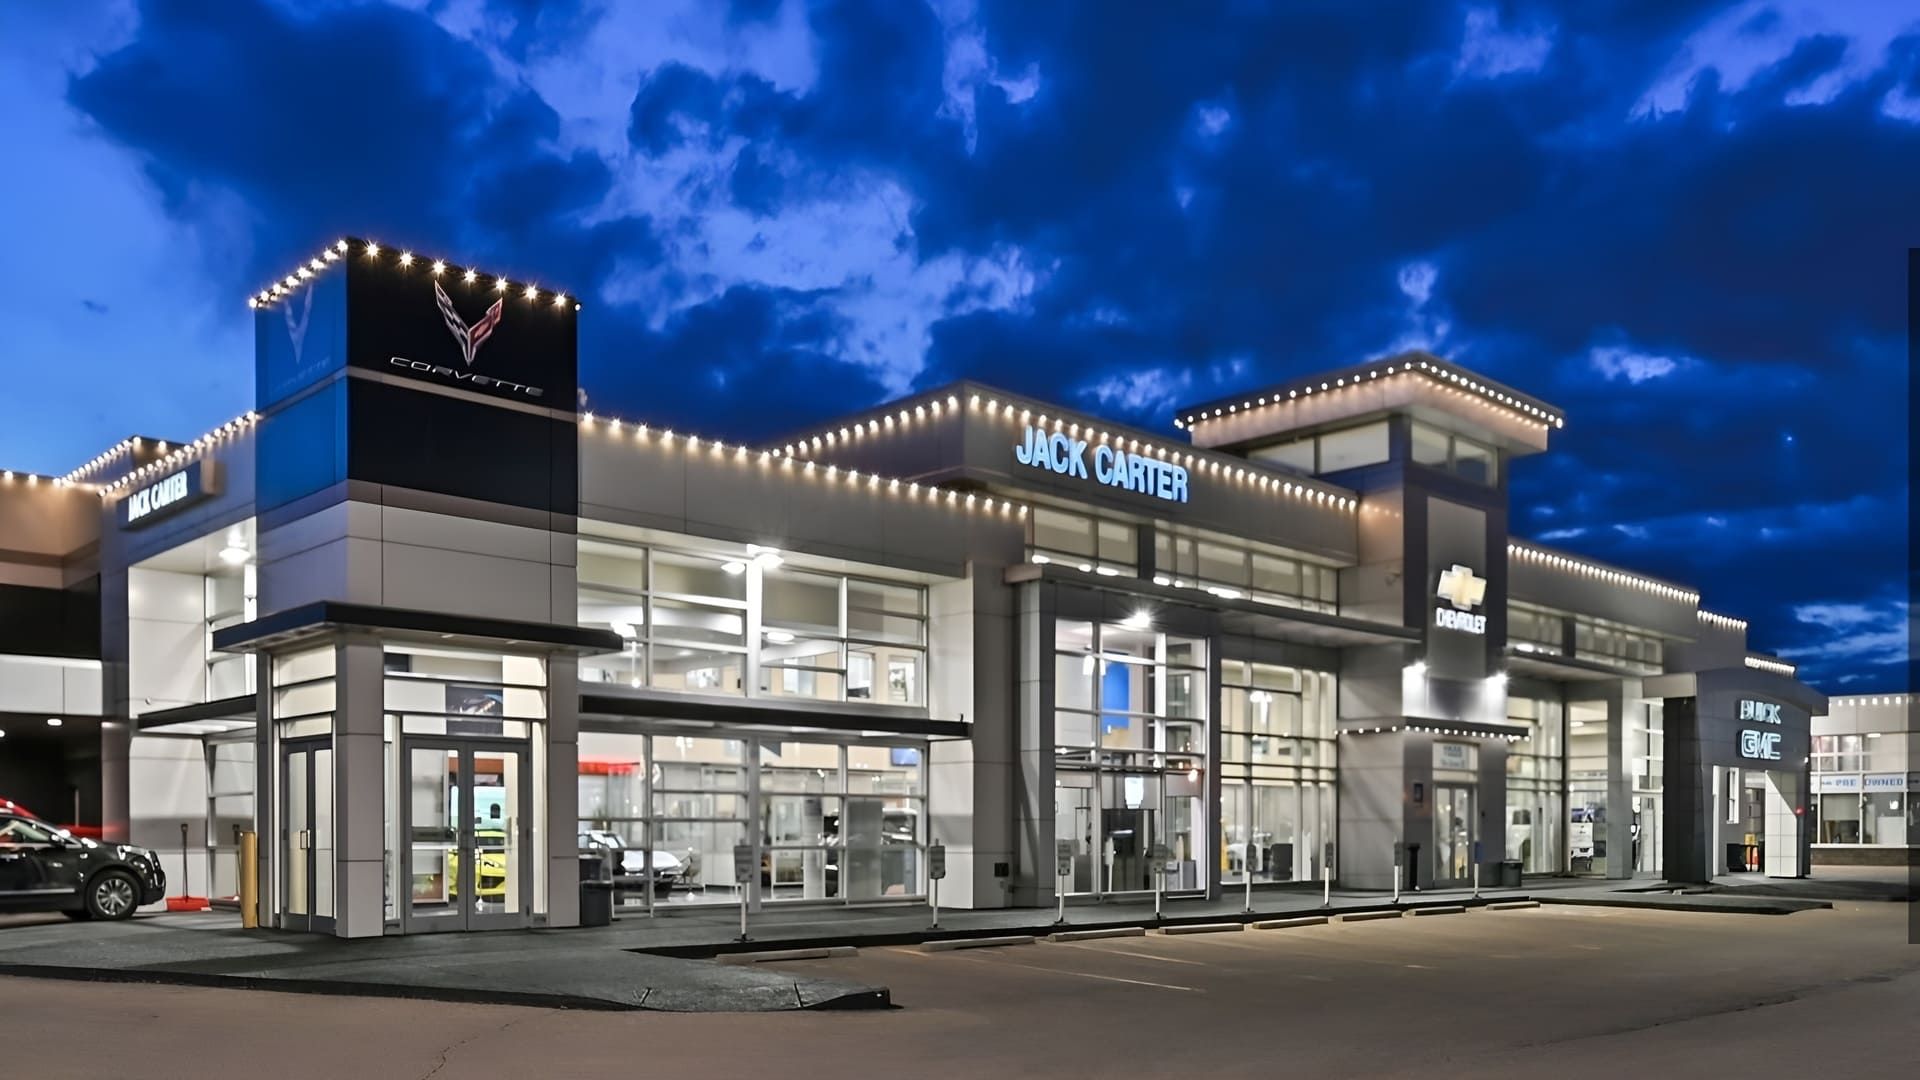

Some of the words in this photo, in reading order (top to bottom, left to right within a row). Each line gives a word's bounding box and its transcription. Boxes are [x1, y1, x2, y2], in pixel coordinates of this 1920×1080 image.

[390, 356, 544, 396] CORVETTE
[1016, 425, 1088, 479] JACK
[1095, 444, 1188, 503] CARTER
[1740, 700, 1781, 725] BUICK
[1741, 729, 1781, 760] GMC
